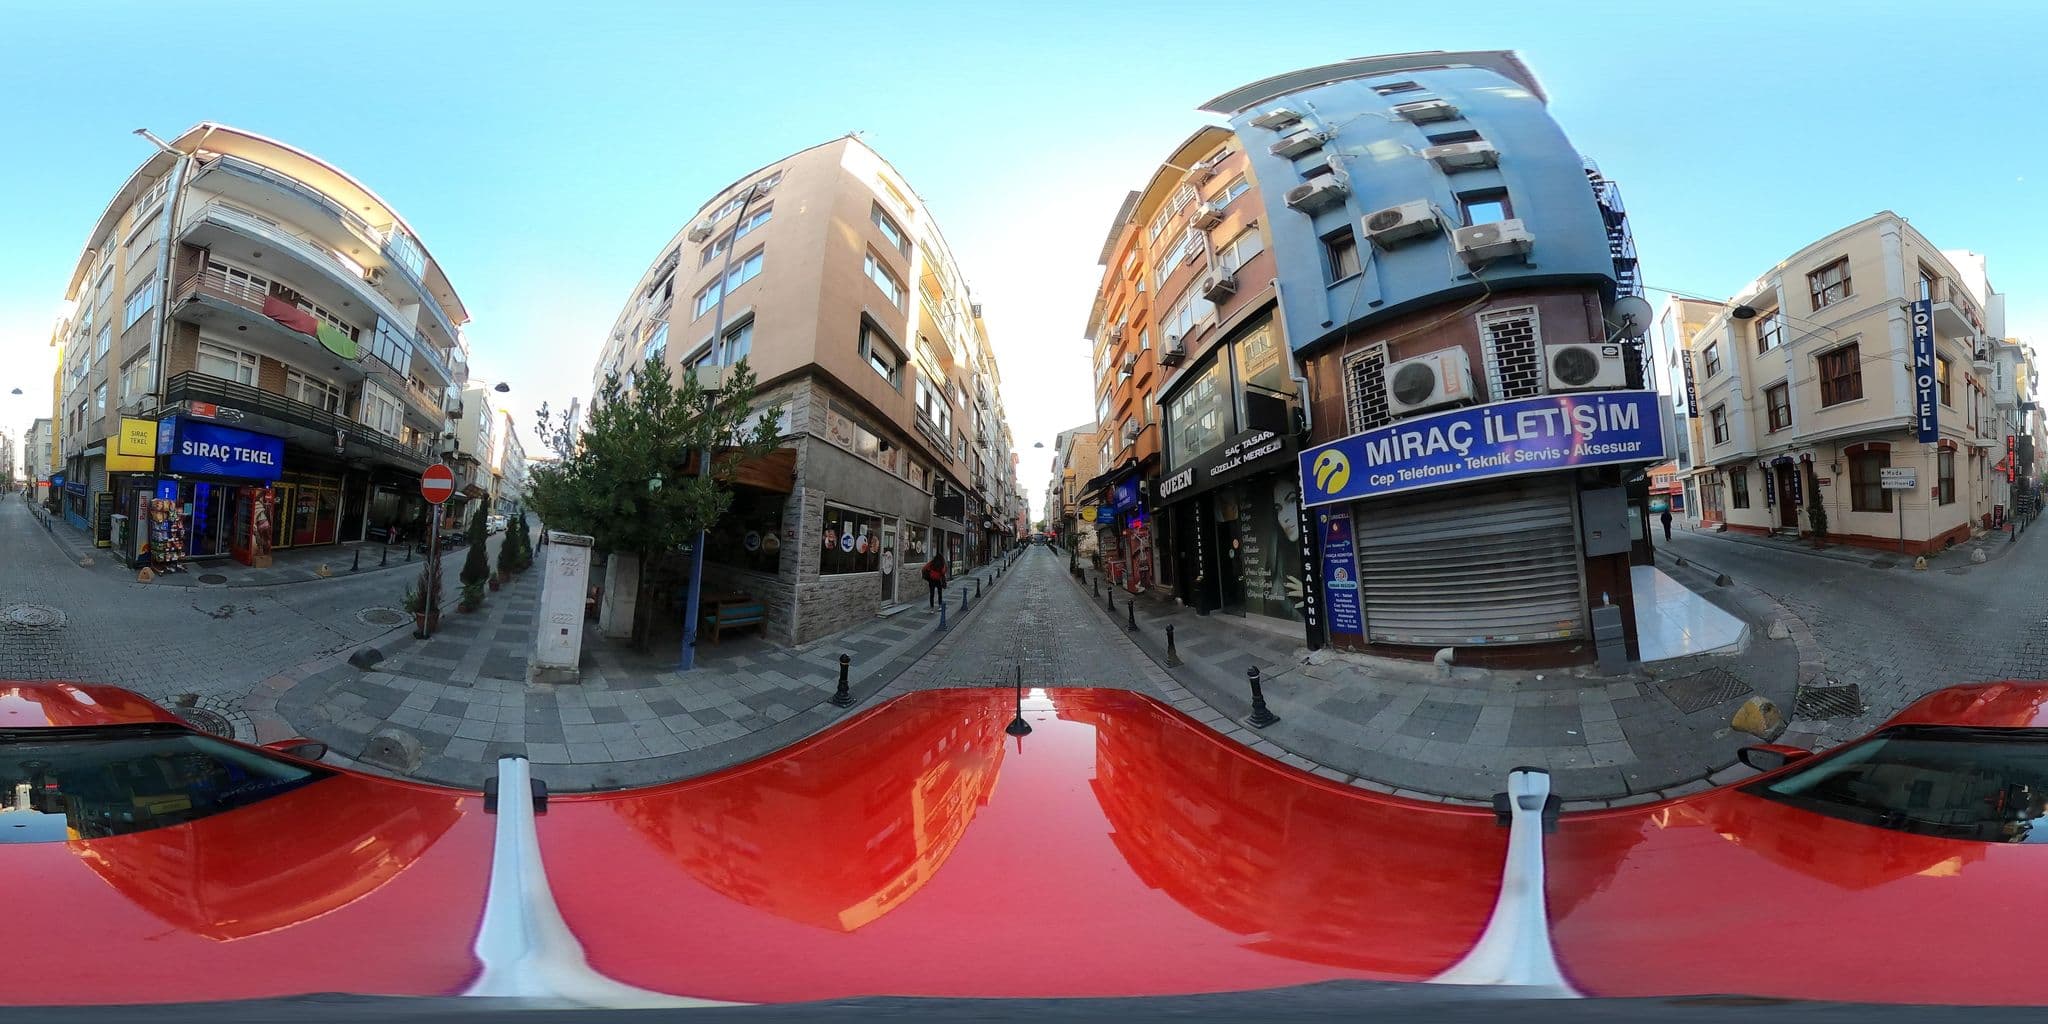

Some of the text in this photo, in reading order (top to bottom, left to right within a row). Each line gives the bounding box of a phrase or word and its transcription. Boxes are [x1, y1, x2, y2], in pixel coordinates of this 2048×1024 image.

[1913, 302, 1932, 431] LORİN OTEL
[1688, 387, 1697, 414] OTEL
[130, 437, 148, 445] TEKEL
[131, 430, 148, 438] SIRAÇ
[1366, 397, 1640, 468] MİRAÇ İLETİŞİM
[182, 440, 274, 466] SIRAÇ TEKEL
[1225, 444, 1240, 458] SAÇ
[1370, 440, 1642, 489] Cep Telefonu Teknik Servis Aksesuar
[1210, 457, 1242, 476] GÜZELLİK
[1160, 467, 1193, 499] QUEEN
[1305, 562, 1316, 626] SALONU
